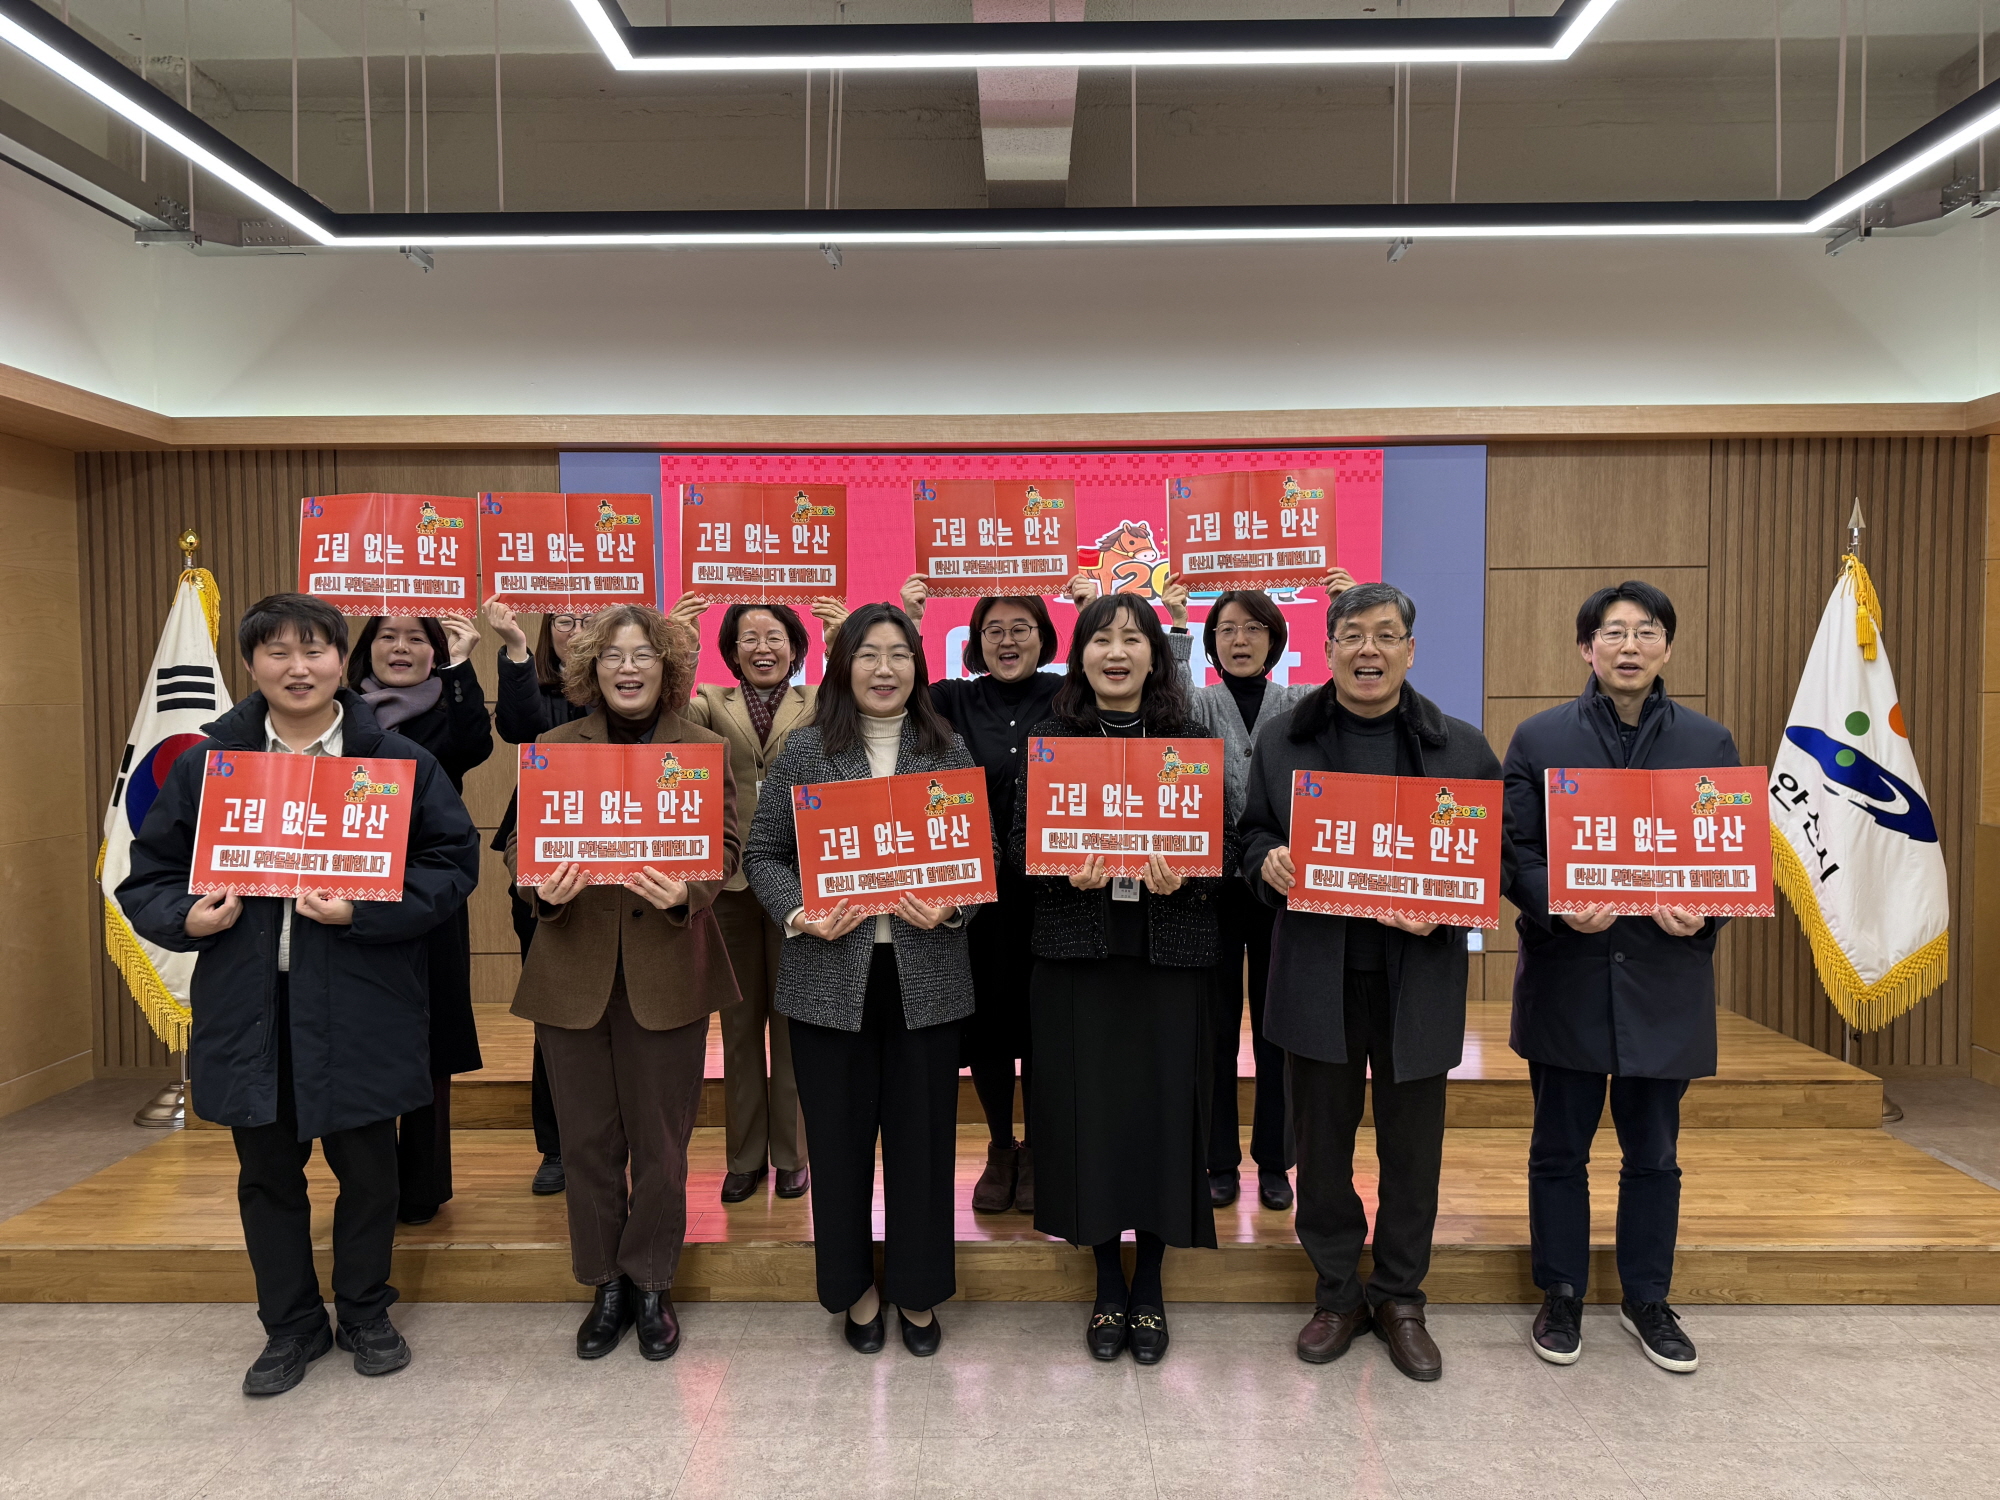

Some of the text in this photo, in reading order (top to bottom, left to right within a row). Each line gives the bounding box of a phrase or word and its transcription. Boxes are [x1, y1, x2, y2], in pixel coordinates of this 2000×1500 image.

[1299, 489, 1323, 498] 2026
[810, 506, 835, 515] 2026
[1041, 499, 1064, 508] 2026
[438, 518, 463, 528] 2026
[616, 515, 640, 524] 2026
[1186, 508, 1319, 542] 고립 없는 안산
[697, 523, 830, 554] 고립 없는 안산
[932, 517, 1060, 546] 고립 없는 안산
[314, 533, 458, 566] 고립 없는 안산
[498, 533, 636, 562] 고립 없는 안산
[935, 558, 1063, 574] 안산시 무한돌봄센터가 함께합니다
[1189, 550, 1321, 570] 안산시 무한돌봄센터가 함께합니다
[501, 576, 639, 591] 안산시 무한돌봄센터가 함께합니다
[698, 566, 832, 582] 안산시 무한돌봄센터가 함께합니다
[314, 577, 460, 595] 안산시 무한돌봄센터가 함께합니다
[680, 769, 709, 779] 2026
[1180, 763, 1209, 774] 2026
[368, 782, 399, 794] 2026
[540, 790, 702, 824] 고립 없는 안산
[946, 793, 974, 806] 2026
[1047, 783, 1202, 818] 고립 없는 안산
[1717, 793, 1751, 804] 2026
[220, 798, 389, 839] 고립 없는 안산
[1455, 806, 1486, 818] 2026
[819, 814, 970, 861] 고립 없는 안산
[1572, 816, 1746, 852] 고립 없는 안산
[1770, 773, 1840, 883] 안산시
[543, 840, 704, 858] 안산시 무한돌봄센터가 함께합니다
[1049, 833, 1203, 852] 안산시 무한돌봄센터가 함께합니다
[1312, 819, 1478, 864] 고립 없는 안산
[219, 849, 385, 872] 안산시 무한돌봄센터가 함께합니다
[825, 862, 976, 893] 안산시 무한돌봄센터가 함께합니다
[1313, 869, 1478, 899] 안산시 무한돌봄센터가 함께합니다
[1574, 868, 1749, 887] 안산시 무한돌봄센터가 함께합니다
